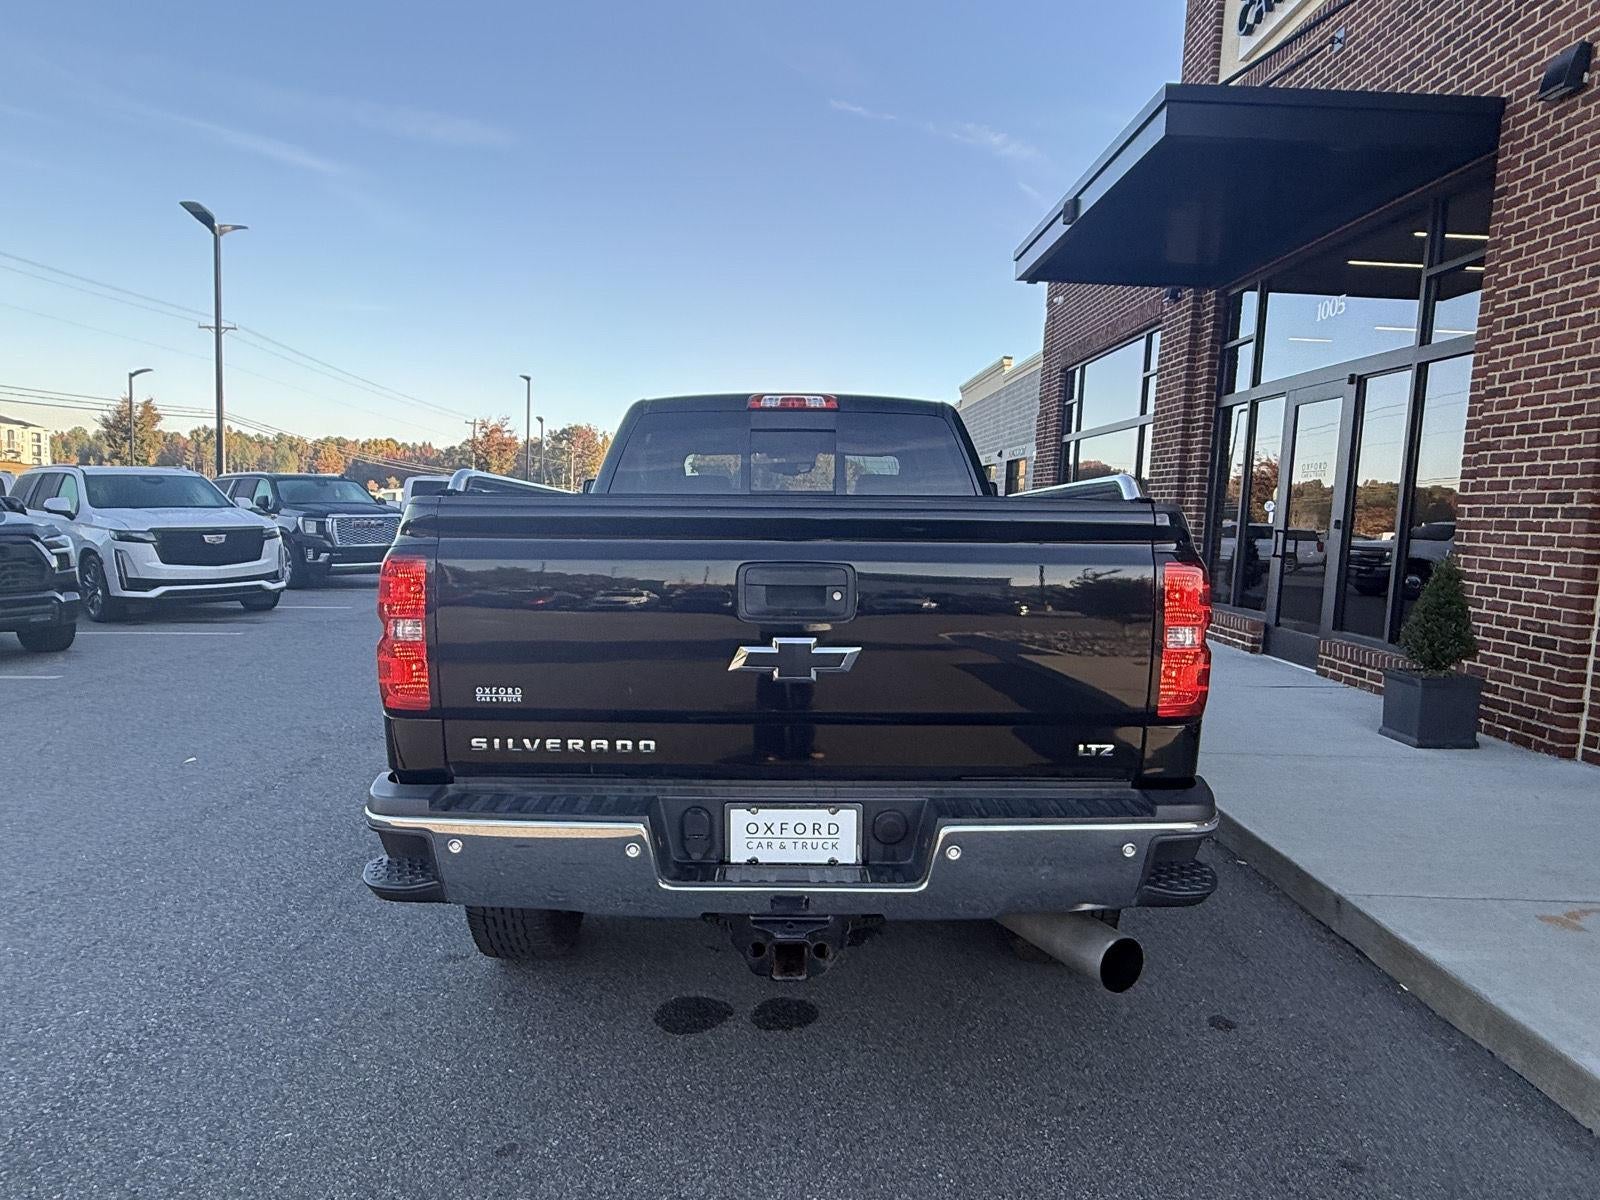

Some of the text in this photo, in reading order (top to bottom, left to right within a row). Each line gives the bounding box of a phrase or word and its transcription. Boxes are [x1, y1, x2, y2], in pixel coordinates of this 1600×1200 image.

[1316, 294, 1347, 322] 1005
[475, 686, 522, 695] OXFORD
[470, 737, 656, 753] SILVERADO
[1078, 743, 1115, 757] LTZ
[745, 822, 840, 836] OXFORD
[746, 841, 839, 851] CAR & TRUCK
